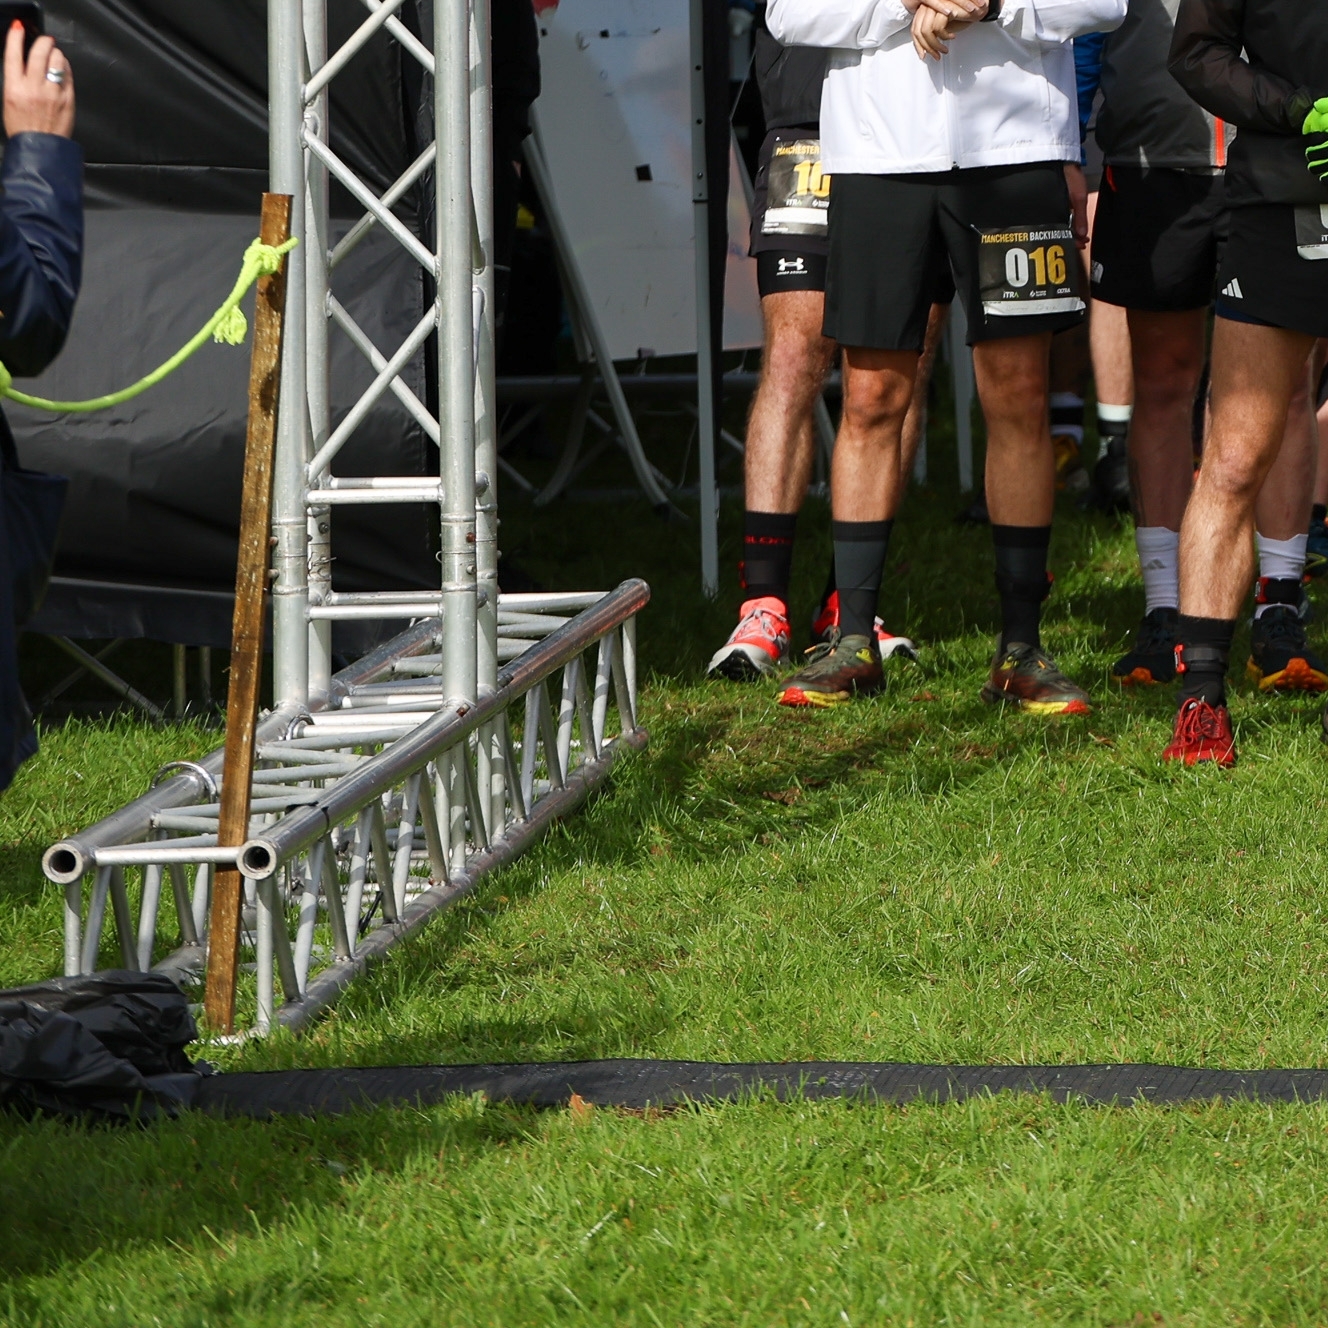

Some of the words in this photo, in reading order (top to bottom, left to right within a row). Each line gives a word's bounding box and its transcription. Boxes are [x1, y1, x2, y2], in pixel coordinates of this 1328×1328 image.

[775, 145, 820, 156] MANCHESTER
[981, 232, 1029, 244] MANCHESTER
[1029, 230, 1062, 242] BACKYARD
[1005, 244, 1066, 288] 016
